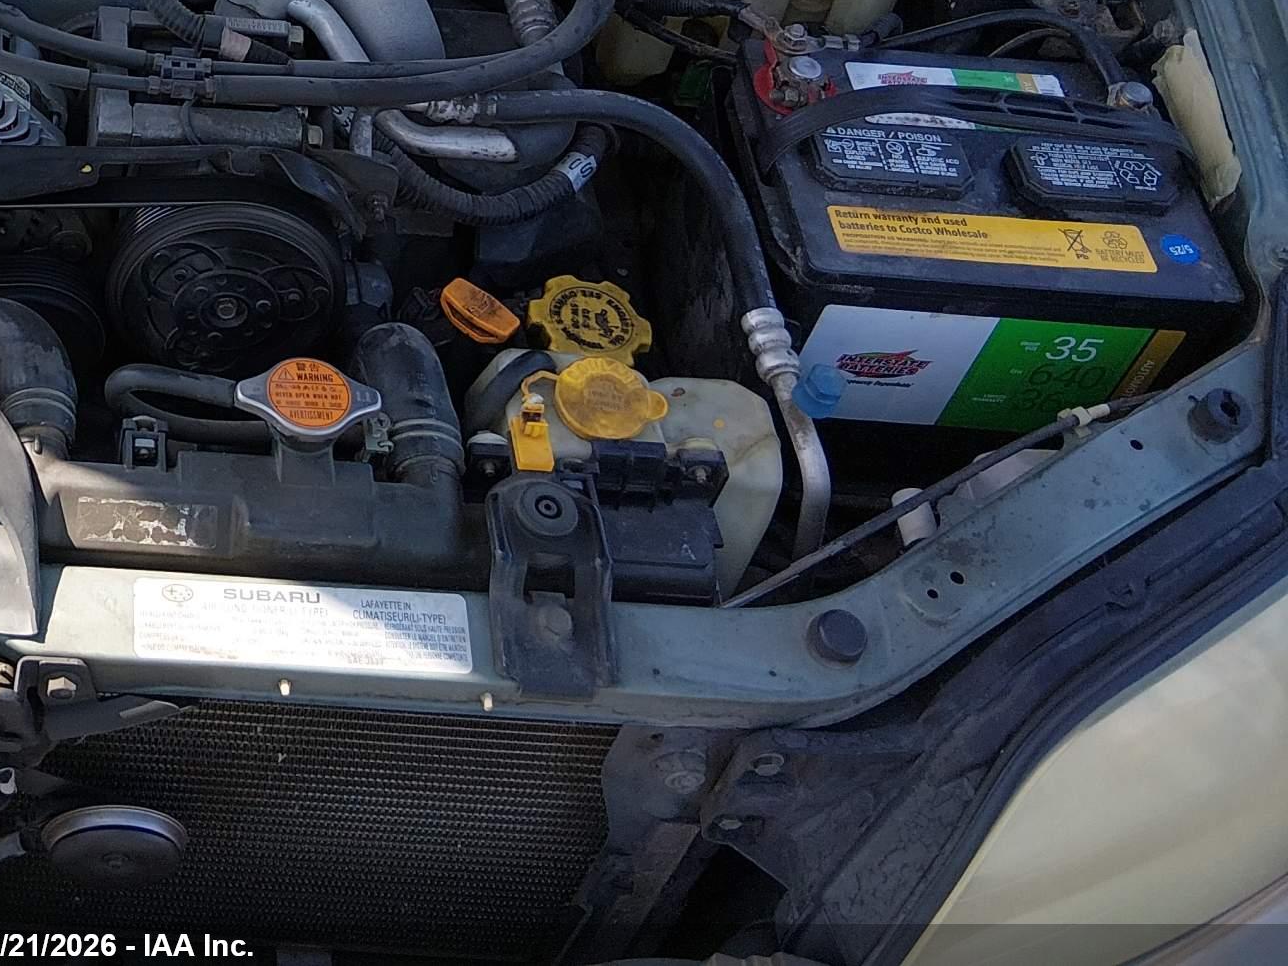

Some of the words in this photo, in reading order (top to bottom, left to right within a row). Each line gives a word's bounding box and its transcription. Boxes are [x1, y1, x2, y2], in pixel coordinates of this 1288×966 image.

[837, 126, 886, 139] DANGER
[897, 131, 943, 143] POISON
[835, 209, 872, 220] Return
[872, 212, 919, 225] warranty
[921, 214, 941, 225] and
[943, 217, 968, 227] used
[839, 220, 885, 232] batteries
[886, 224, 897, 233] to
[899, 224, 933, 235] Costco
[934, 227, 990, 239] Wholesale
[1045, 336, 1104, 363] 35
[835, 353, 932, 370] INTERSTATE
[835, 362, 920, 376] BATTERIES
[296, 372, 333, 383] WARNING
[1028, 362, 1107, 389] 640
[223, 588, 321, 604] SUBARU
[360, 599, 403, 611] LAFAYETTE
